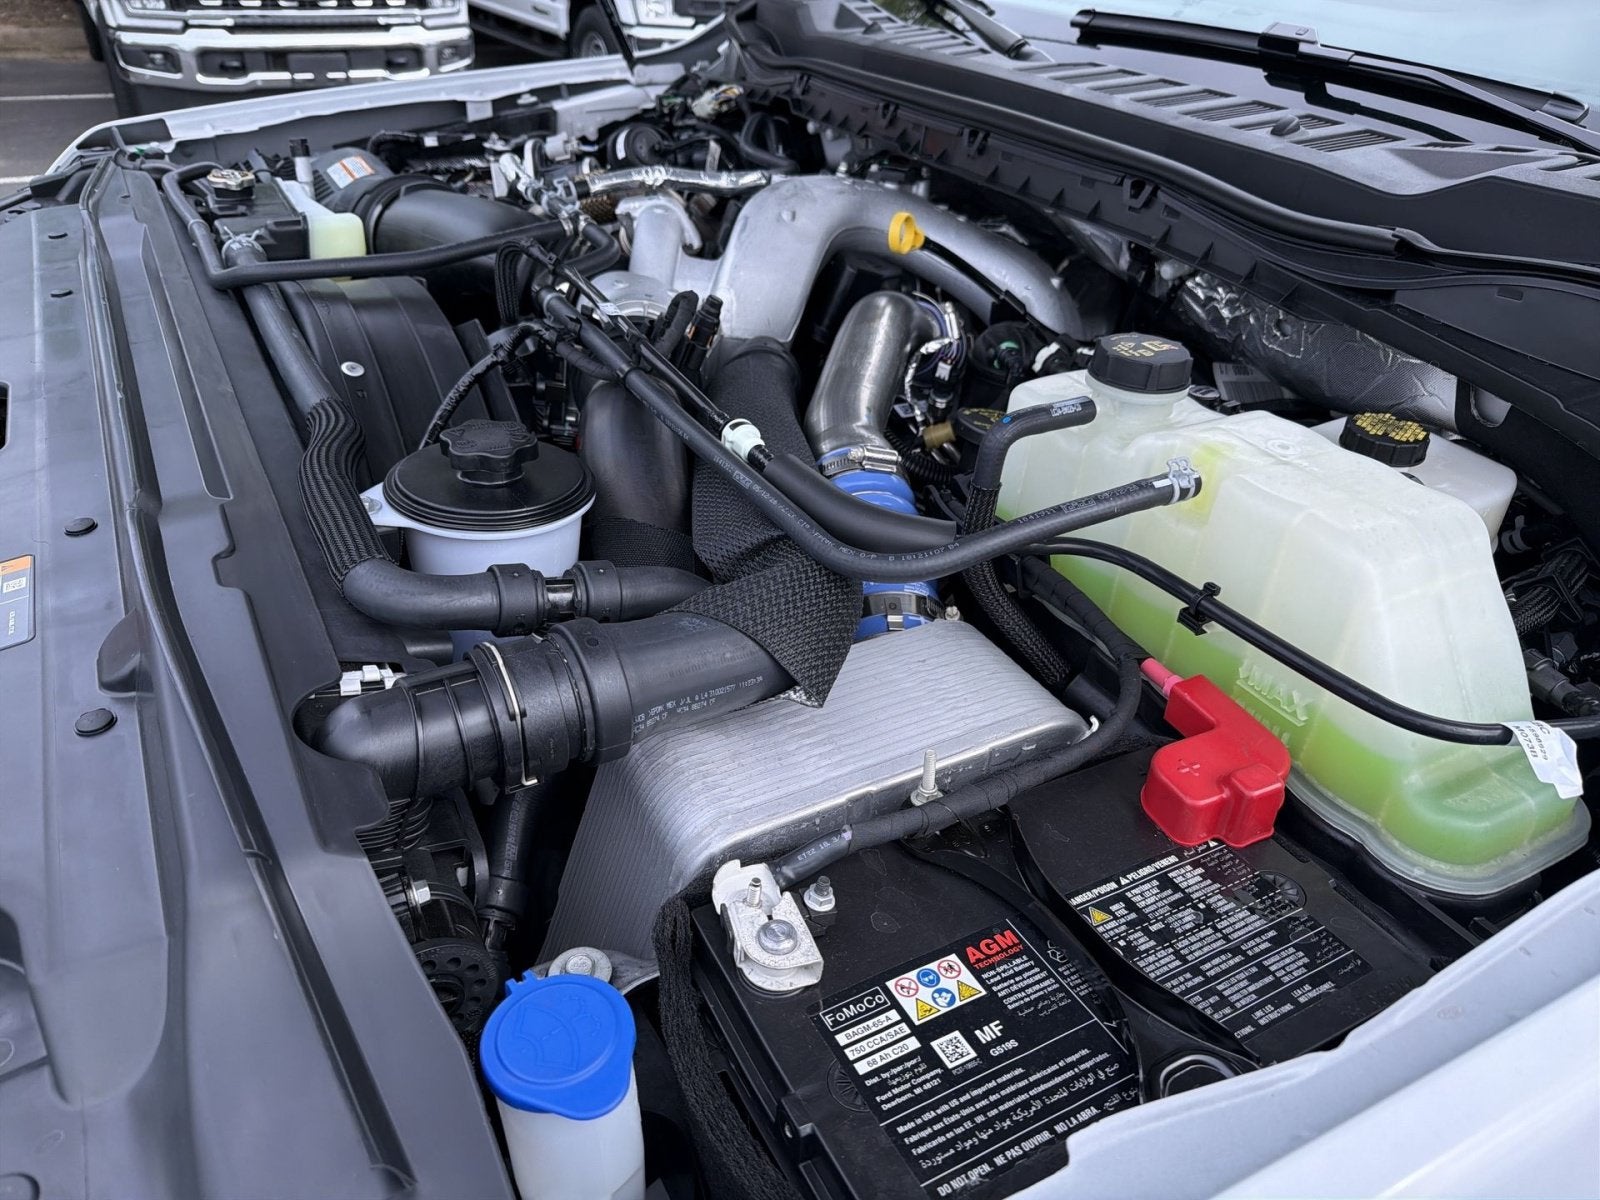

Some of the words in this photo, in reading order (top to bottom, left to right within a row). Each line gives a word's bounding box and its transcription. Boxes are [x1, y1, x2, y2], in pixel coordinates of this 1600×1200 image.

[966, 930, 1019, 964] AGM
[973, 944, 1023, 969] TECHNOLOGY
[981, 955, 1029, 981] NON-SPILLABLE
[985, 975, 1001, 985] Lead
[1001, 969, 1014, 978] Acid
[1013, 960, 1035, 972] Battery
[992, 979, 1015, 992] Batterie
[1022, 967, 1040, 979] plomb
[826, 993, 885, 1026] FoMoCo
[1003, 991, 1027, 1005] CONTRA
[844, 1015, 893, 1041] BAGM-65-A
[974, 1020, 1003, 1044] MF
[1234, 1025, 1256, 1039] CTIONS.
[849, 1045, 866, 1057] 750
[866, 1026, 907, 1049] CCA/SAE
[990, 1039, 1019, 1056] G519S
[866, 1058, 878, 1068] 68
[879, 1053, 892, 1062] Ah
[891, 1043, 909, 1055] C20
[864, 1076, 882, 1086] Dist.
[875, 1091, 893, 1102] Ford
[891, 1082, 911, 1095] Motor
[911, 1068, 944, 1085] Company,
[881, 1093, 915, 1110] Dearborn,
[913, 1087, 923, 1095] MI
[923, 1078, 941, 1090] 48121
[896, 1121, 916, 1134] Made
[921, 1111, 937, 1121] USA
[935, 1104, 950, 1114] with
[948, 1099, 959, 1107] US
[958, 1093, 971, 1103] and
[969, 1080, 997, 1097] imported
[996, 1068, 1026, 1084] materials.
[904, 1127, 933, 1145] Fabriqué
[932, 1122, 945, 1131] aux
[974, 1099, 990, 1109] avec
[988, 1093, 1001, 1102] des
[945, 1131, 955, 1139] en
[953, 1126, 965, 1134] los
[963, 1120, 976, 1129] EE.
[974, 1114, 987, 1124] UU.
[987, 1108, 999, 1117] con
[998, 1093, 1030, 1111] materiales
[937, 1183, 952, 1196] DO
[950, 1174, 972, 1189] NOT
[967, 1163, 994, 1182] OPEN.
[993, 1154, 1008, 1166] NE
[1005, 1146, 1023, 1160] PAS
[1021, 1130, 1055, 1151] OUVRIR.
[1054, 1122, 1068, 1134] NO
[1065, 1117, 1081, 1128] LA
[1076, 1106, 1101, 1122] ABRA.
